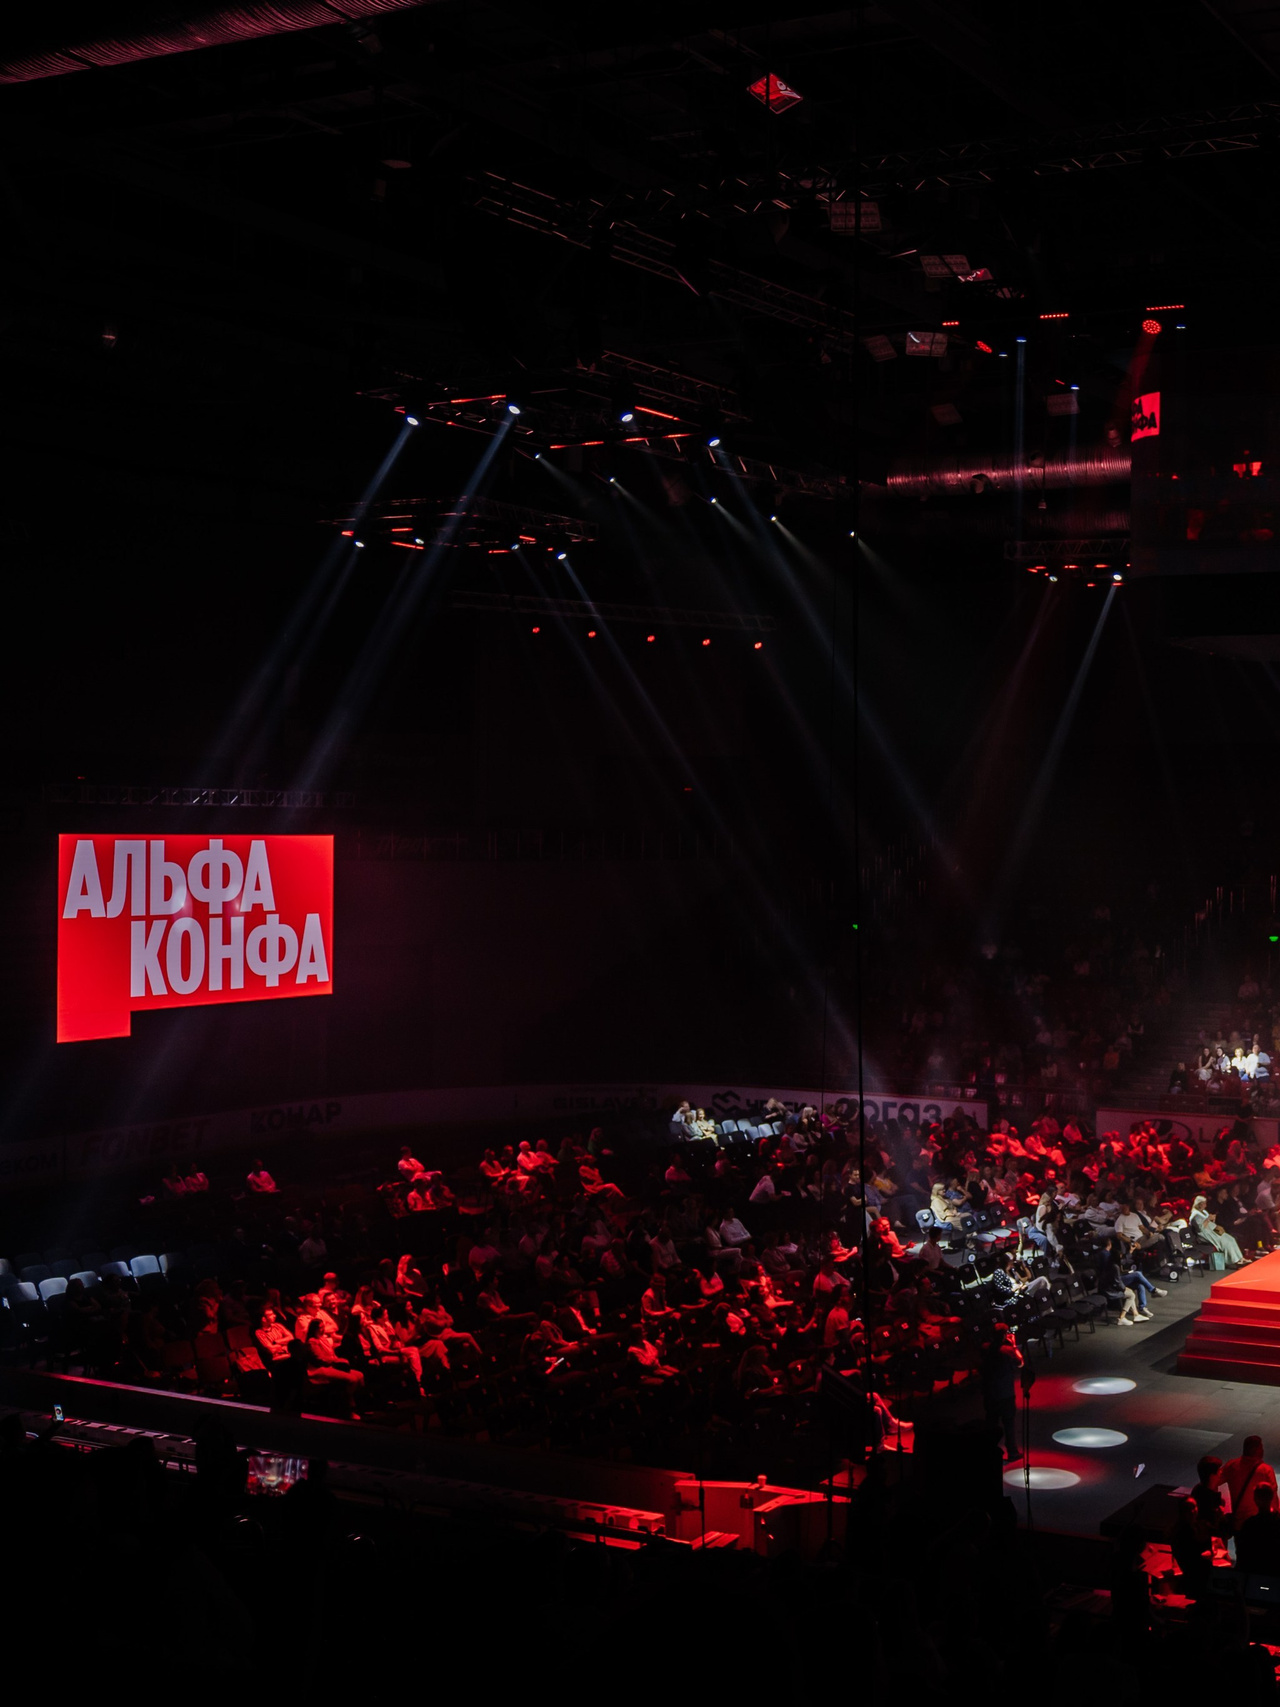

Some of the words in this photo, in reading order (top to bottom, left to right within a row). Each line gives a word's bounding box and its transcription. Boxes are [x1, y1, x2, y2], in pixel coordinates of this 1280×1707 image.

[62, 839, 276, 919] АЛЬФА
[130, 913, 329, 998] КОНФА
[80, 1117, 211, 1166] FONBET
